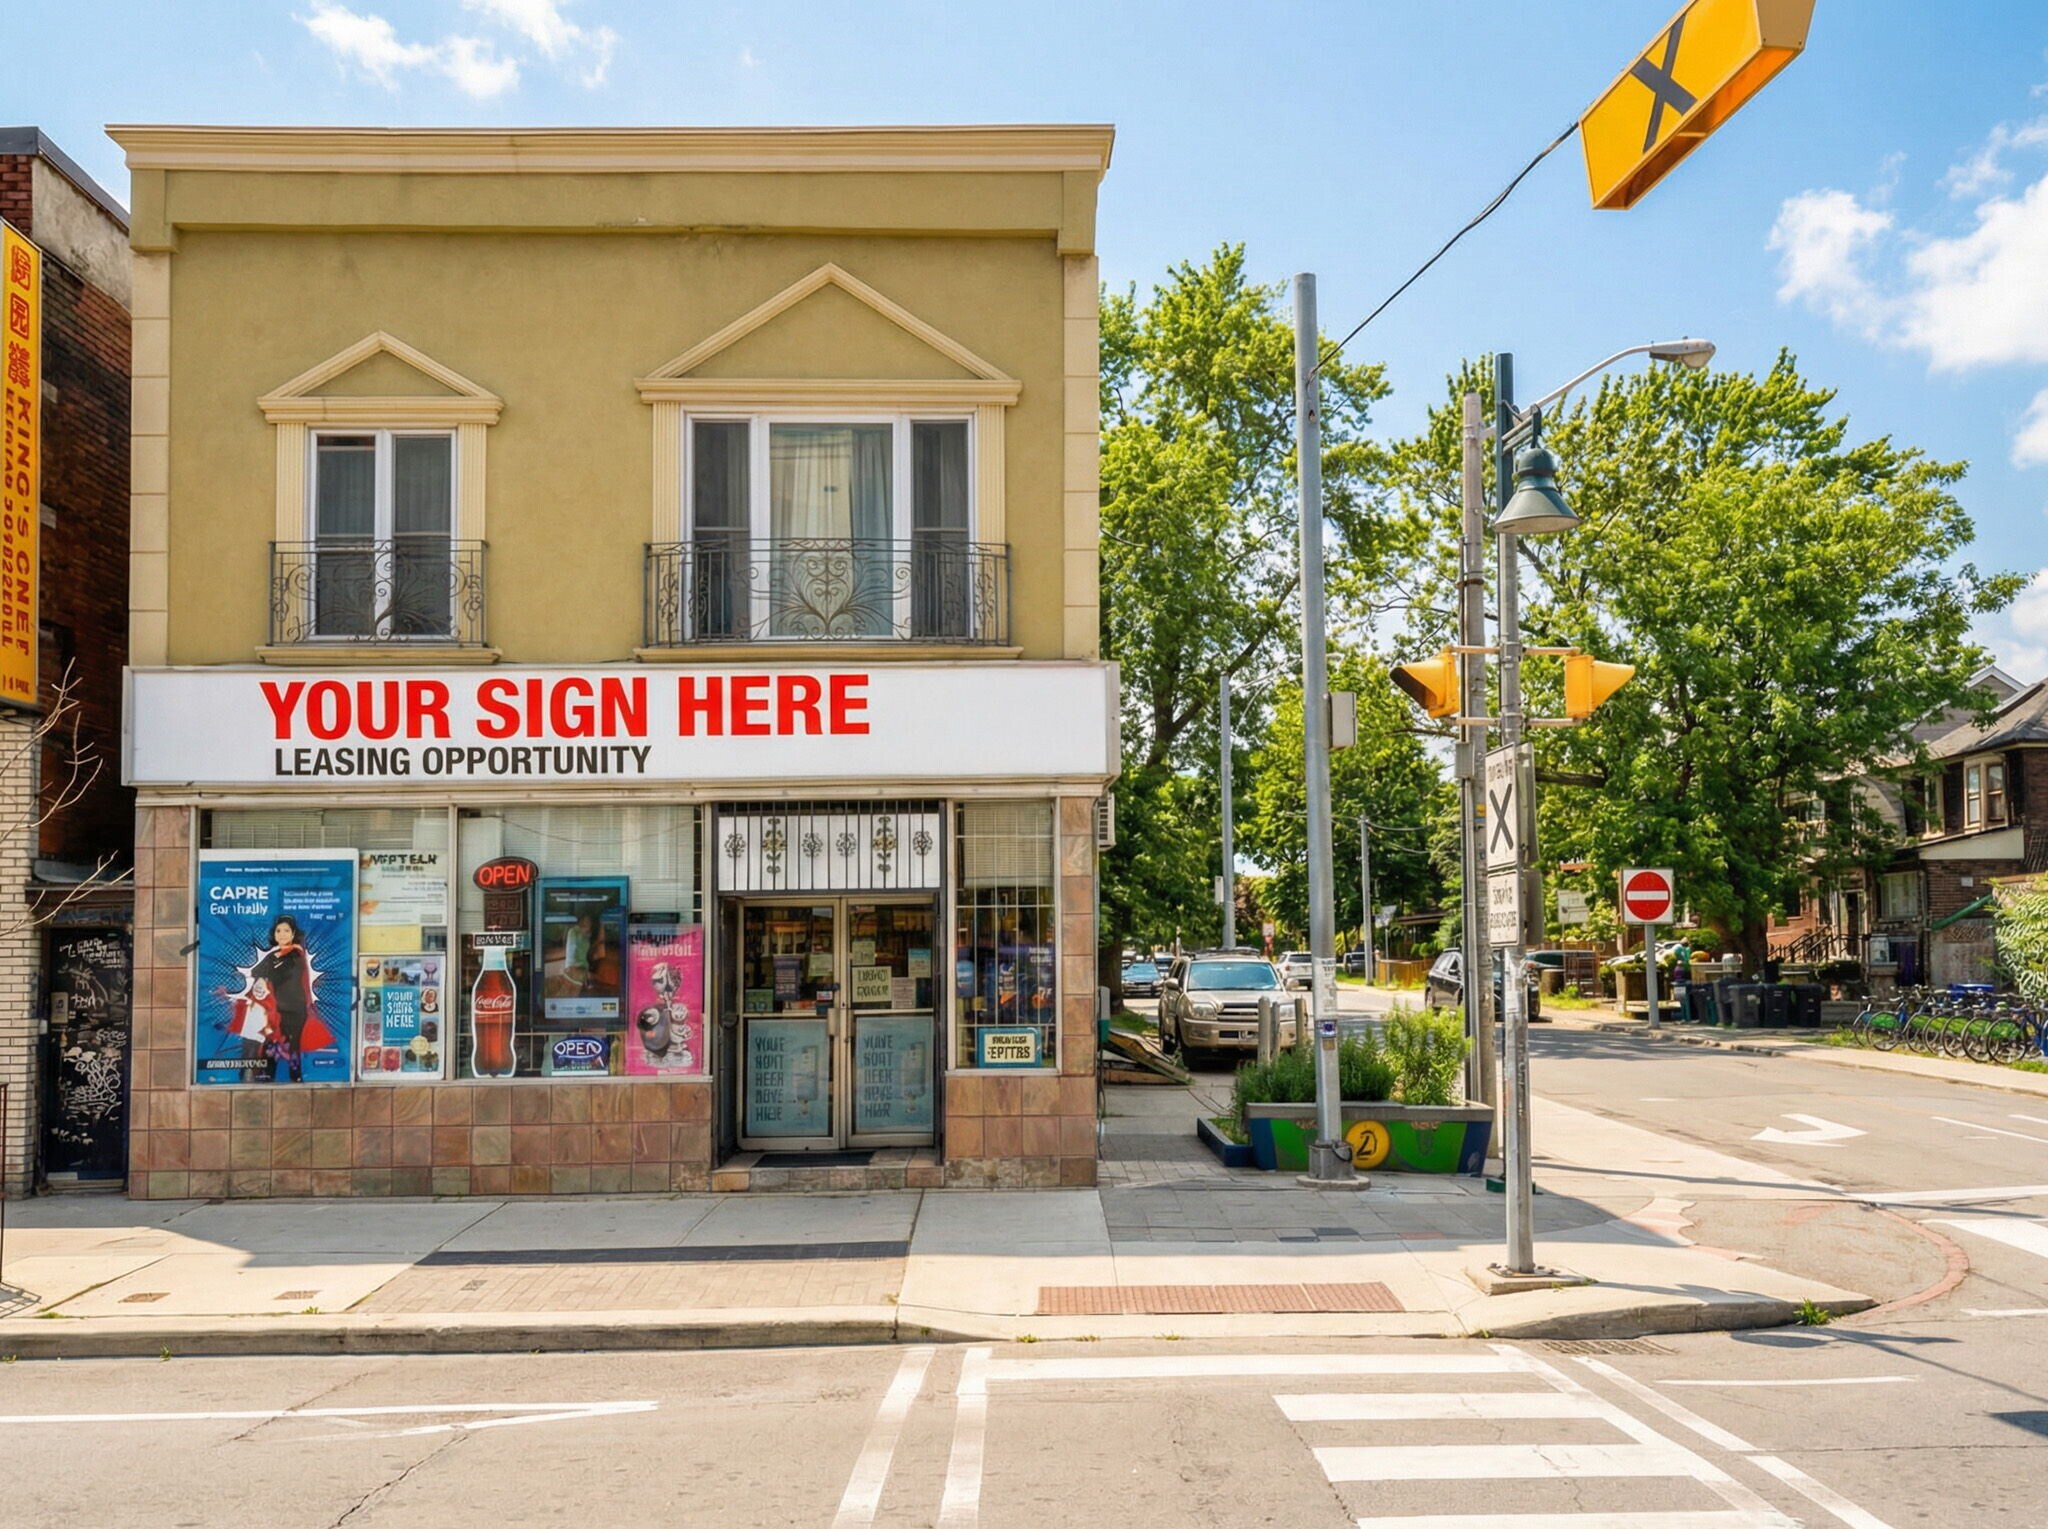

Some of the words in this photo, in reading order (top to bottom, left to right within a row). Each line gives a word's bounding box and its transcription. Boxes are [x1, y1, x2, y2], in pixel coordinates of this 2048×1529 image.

[259, 680, 451, 740] YOUR
[476, 677, 648, 739] SIGN
[678, 674, 870, 737] HERE
[275, 748, 411, 776] LEASING
[422, 745, 651, 775] OPPORTUNITY
[479, 863, 530, 886] OPEN
[210, 886, 269, 900] CAPRE
[554, 1041, 602, 1056] OPEN
